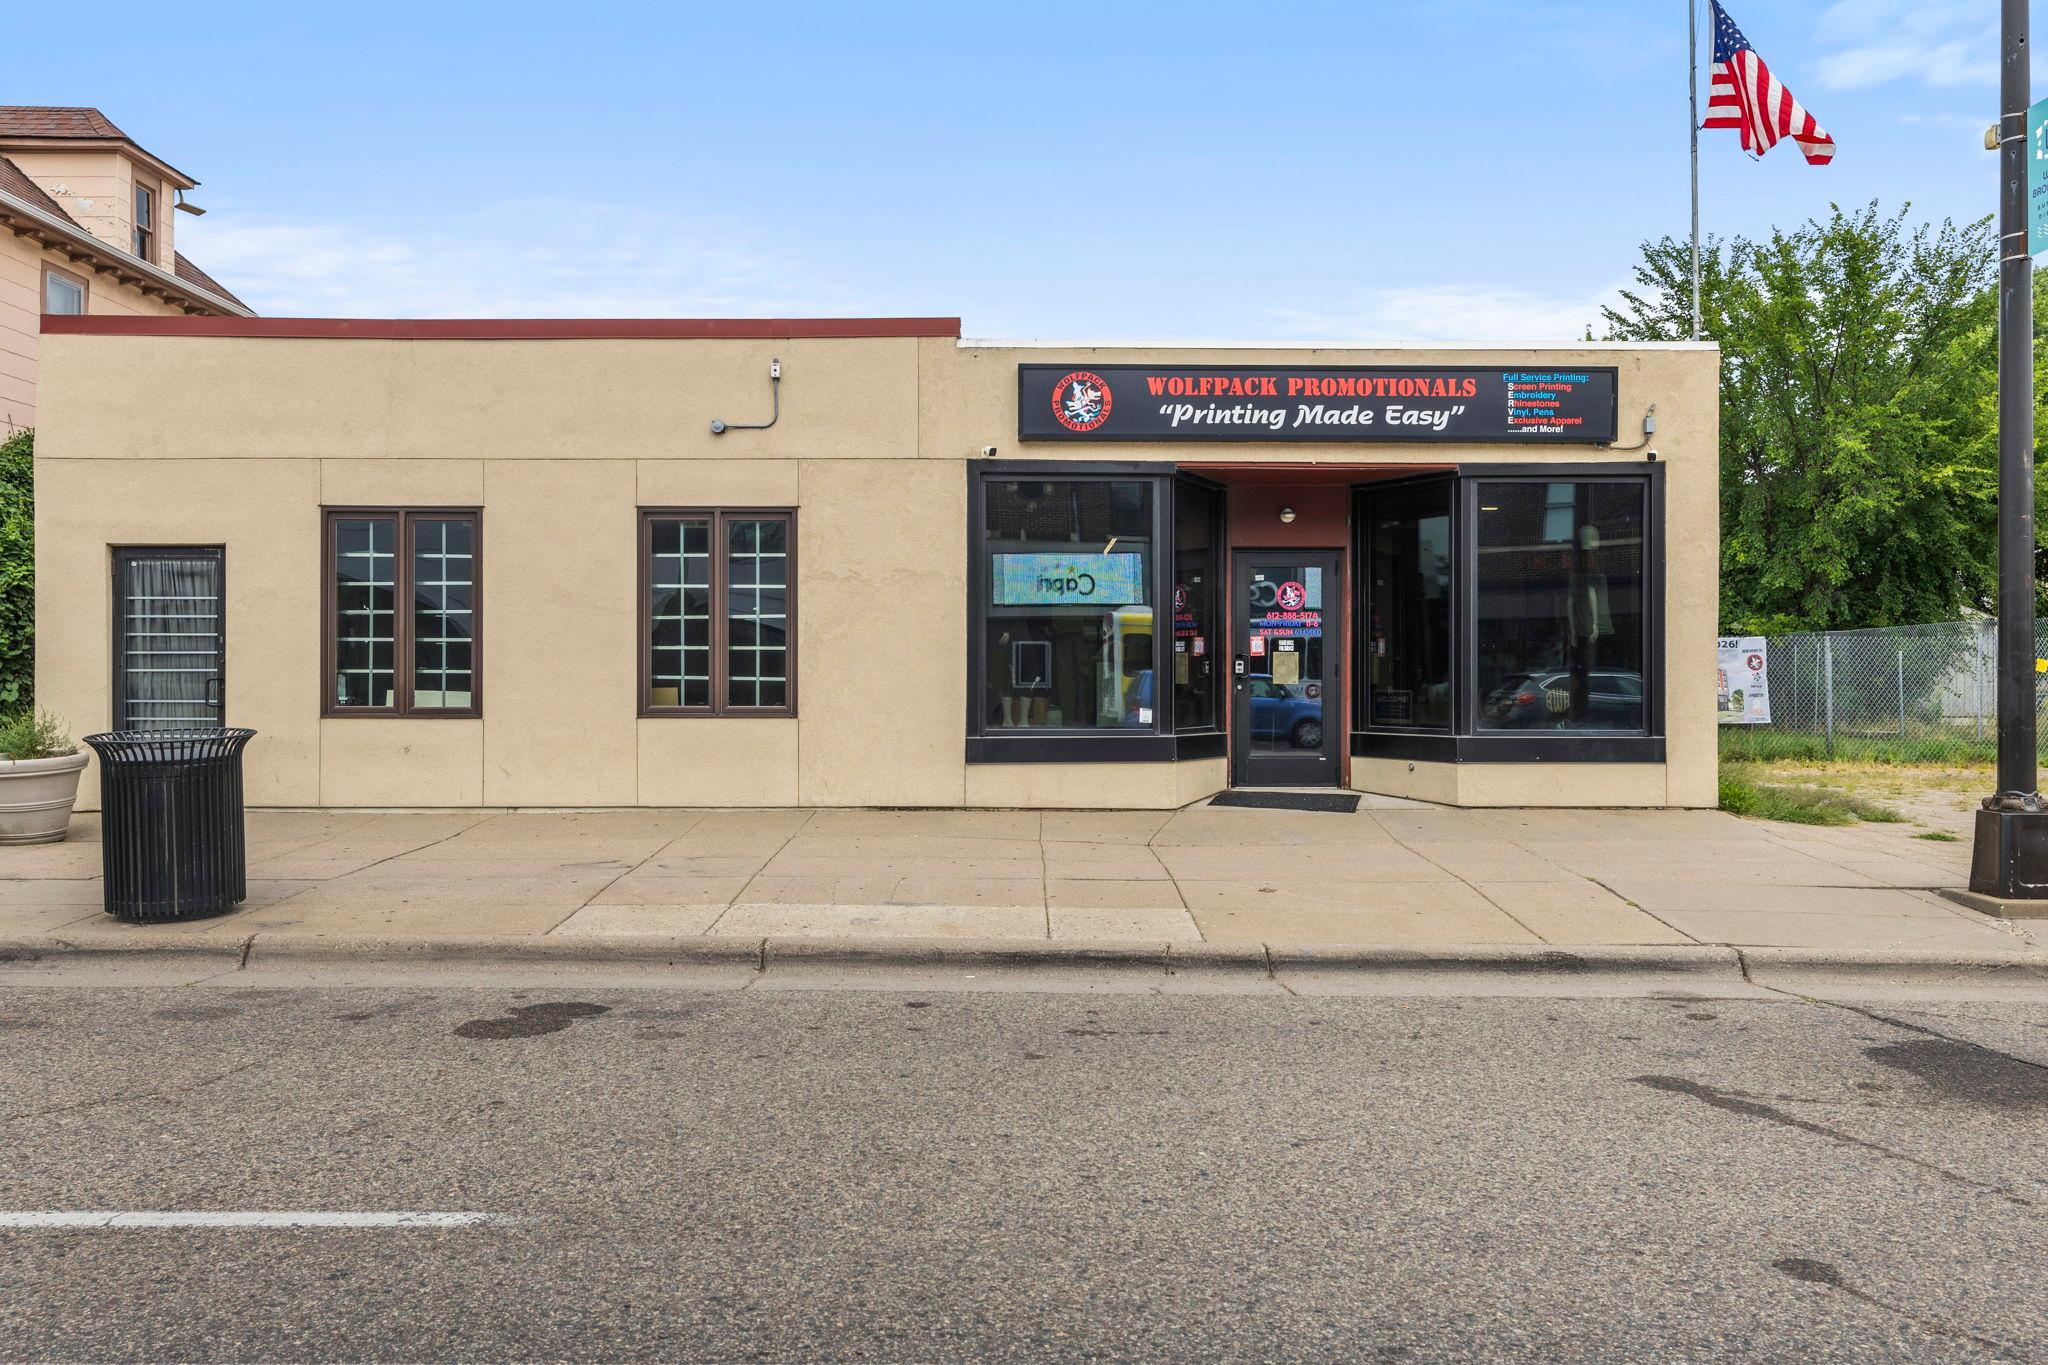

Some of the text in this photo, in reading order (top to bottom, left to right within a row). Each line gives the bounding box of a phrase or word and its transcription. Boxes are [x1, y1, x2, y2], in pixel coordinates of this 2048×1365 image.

[1056, 372, 1106, 390] WOLFPACK
[1503, 373, 1590, 383] Full Service Printing:
[1146, 376, 1477, 398] WOLFPACK PROMOTIONALS
[1507, 382, 1572, 392] Screen Printing
[1507, 391, 1556, 400] Embroidery
[1507, 400, 1561, 408] Rhinestones
[1052, 400, 1111, 431] PROMOTIONALS
[1292, 404, 1374, 430] Made
[1507, 408, 1554, 417] Vinyl, Pens
[1507, 416, 1583, 426] Exclusive Apparel
[1539, 425, 1564, 433] More!
[1259, 628, 1272, 636] SAT
